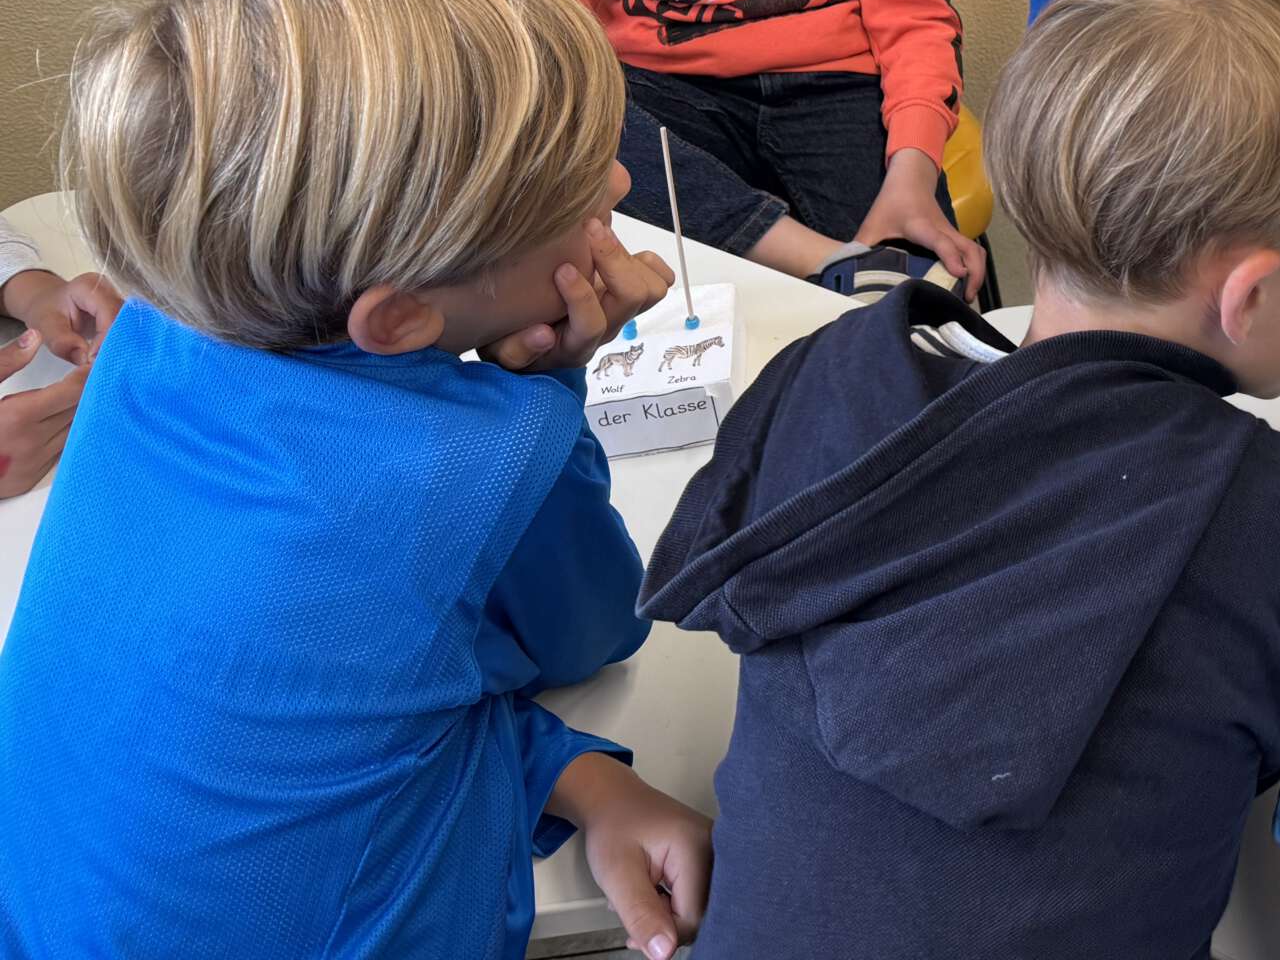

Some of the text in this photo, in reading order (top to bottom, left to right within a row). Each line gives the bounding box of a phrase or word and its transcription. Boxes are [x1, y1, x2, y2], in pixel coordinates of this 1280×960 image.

[667, 375, 697, 385] Zebra
[600, 385, 625, 395] Wolf
[598, 400, 708, 428] der Klasse
